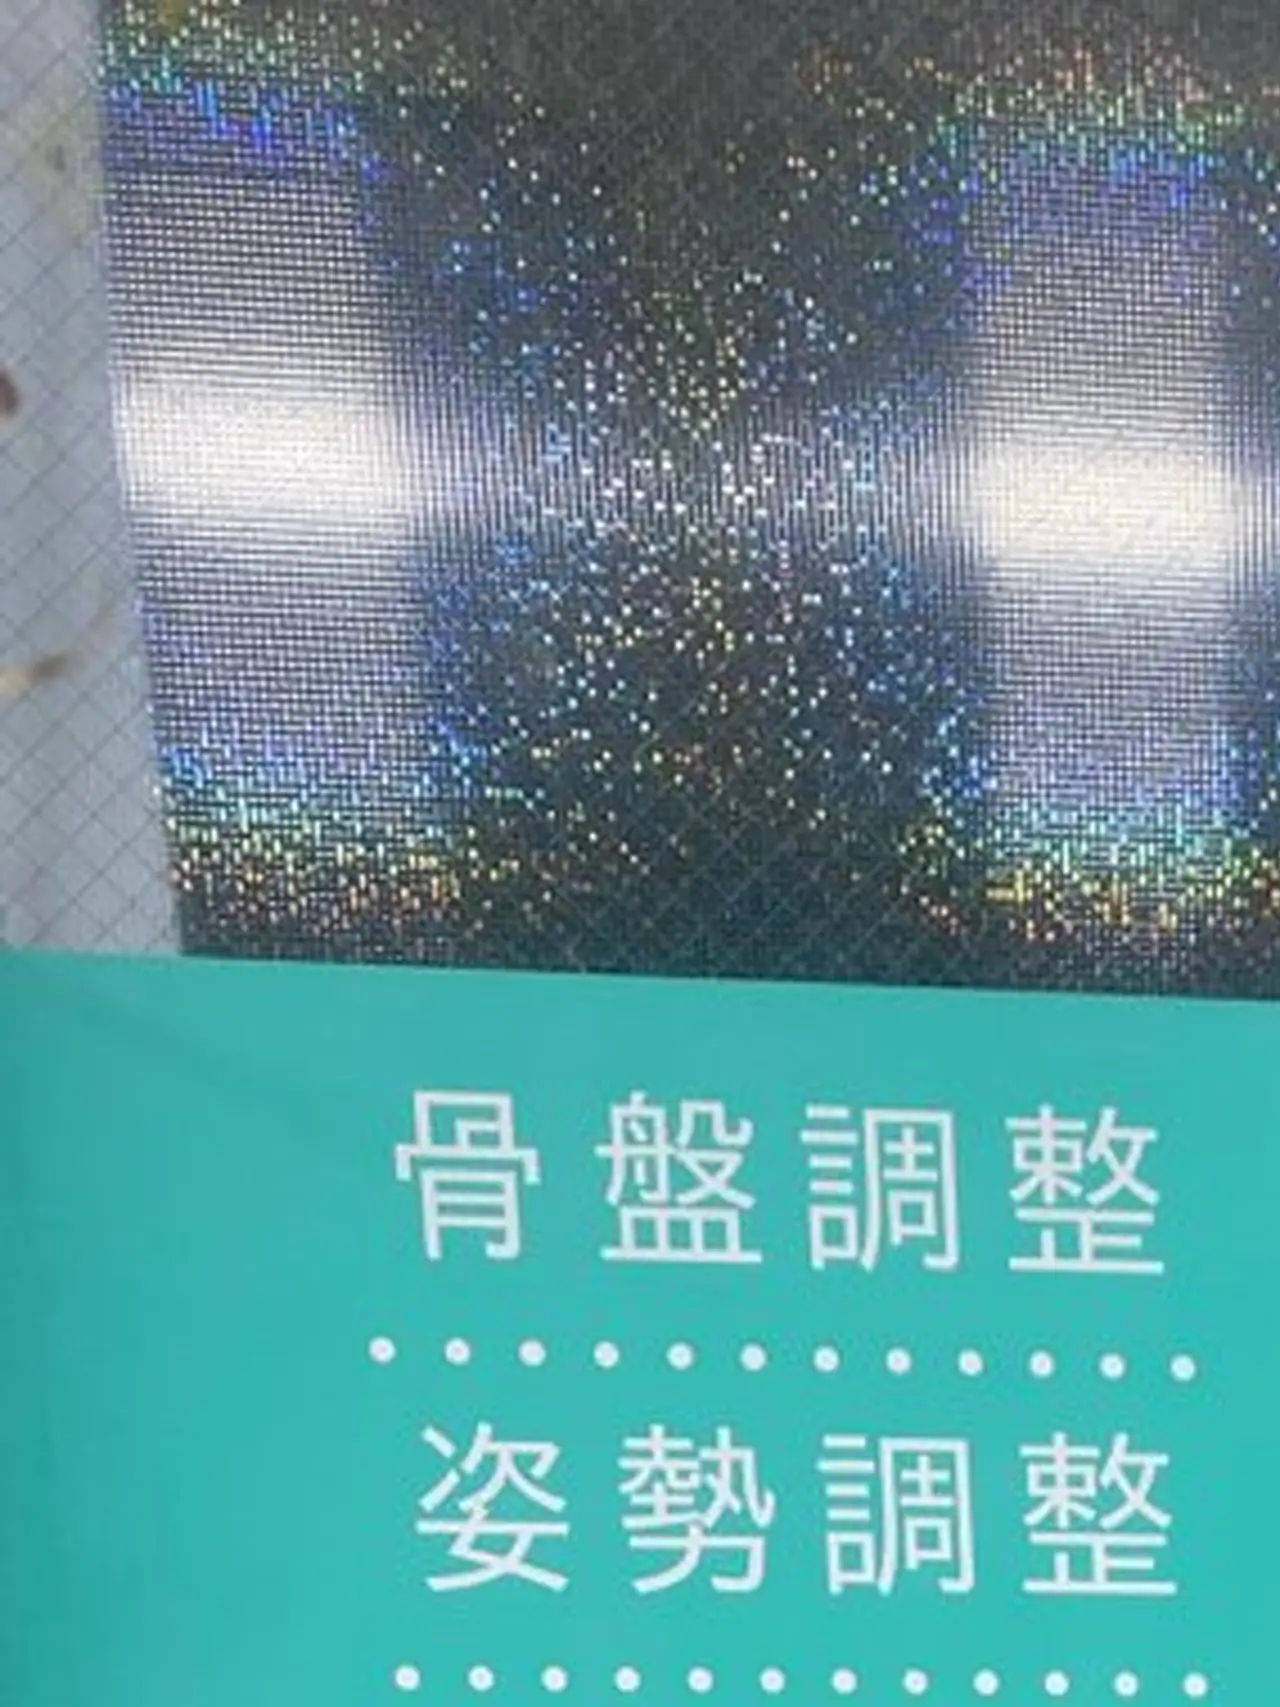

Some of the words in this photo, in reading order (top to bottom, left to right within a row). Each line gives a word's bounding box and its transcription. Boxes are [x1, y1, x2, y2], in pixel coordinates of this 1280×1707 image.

[393, 1089, 1165, 1275] 骨盤調整
[415, 1422, 1178, 1596] 姿勢調整
